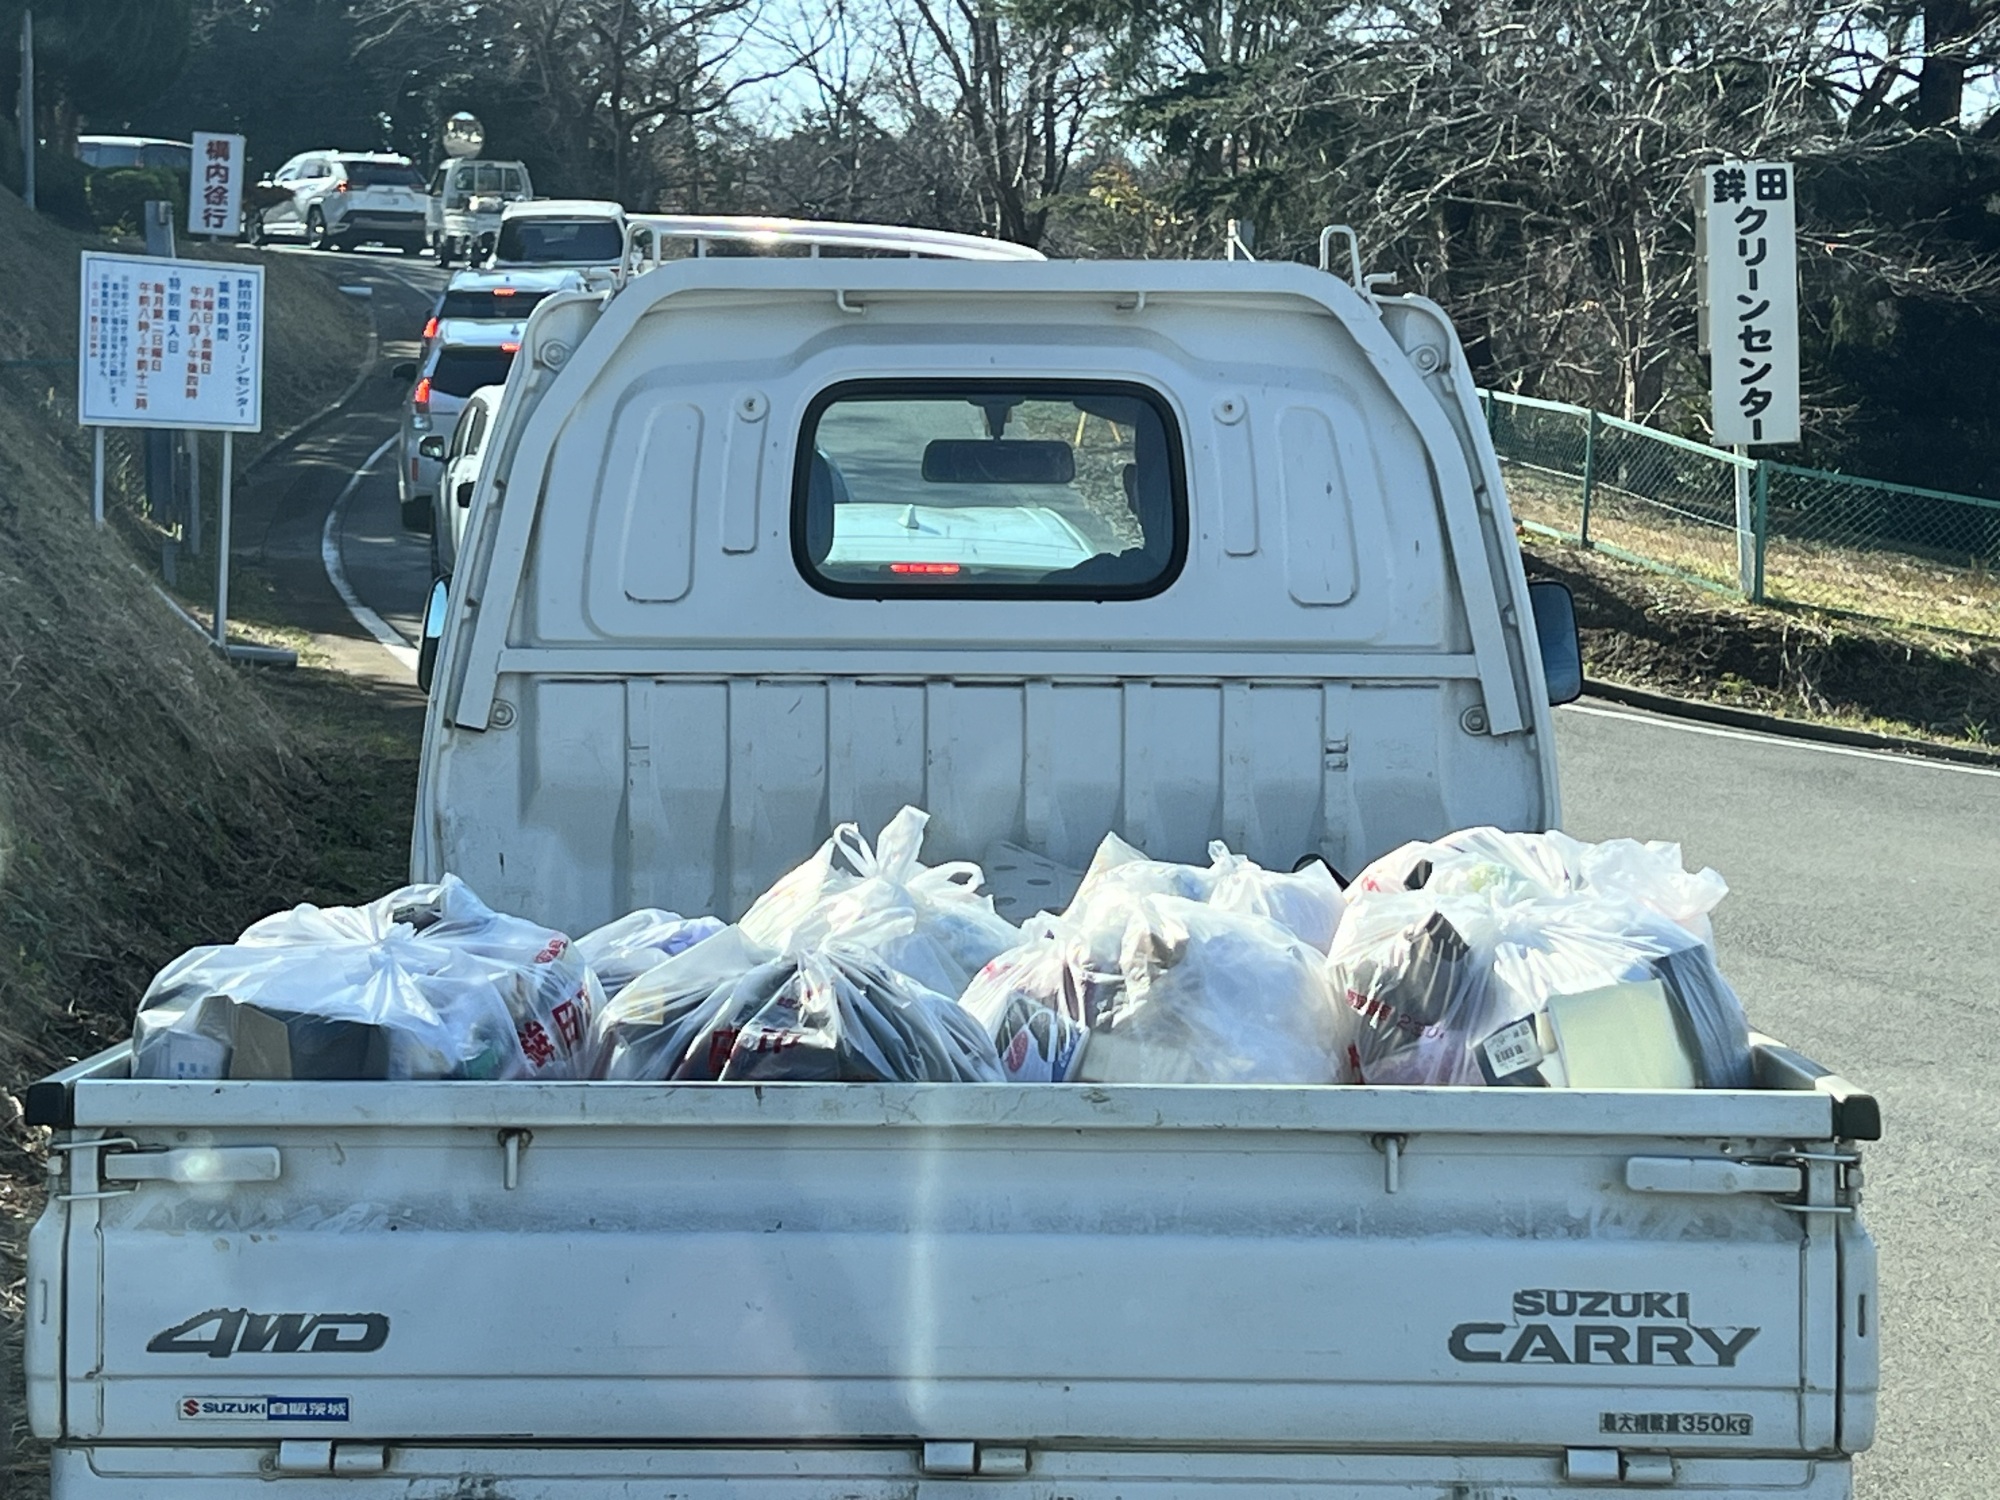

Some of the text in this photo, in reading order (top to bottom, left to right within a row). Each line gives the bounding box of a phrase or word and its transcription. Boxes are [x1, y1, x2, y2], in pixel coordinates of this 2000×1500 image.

[1712, 168, 1788, 204] 鉾田
[1734, 206, 1773, 441] クリーンセンター
[1513, 1290, 1690, 1318] SUZUKI
[146, 1307, 390, 1358] 4WD
[1447, 1322, 1761, 1366] CARRY
[202, 1402, 266, 1414] SUZUKI
